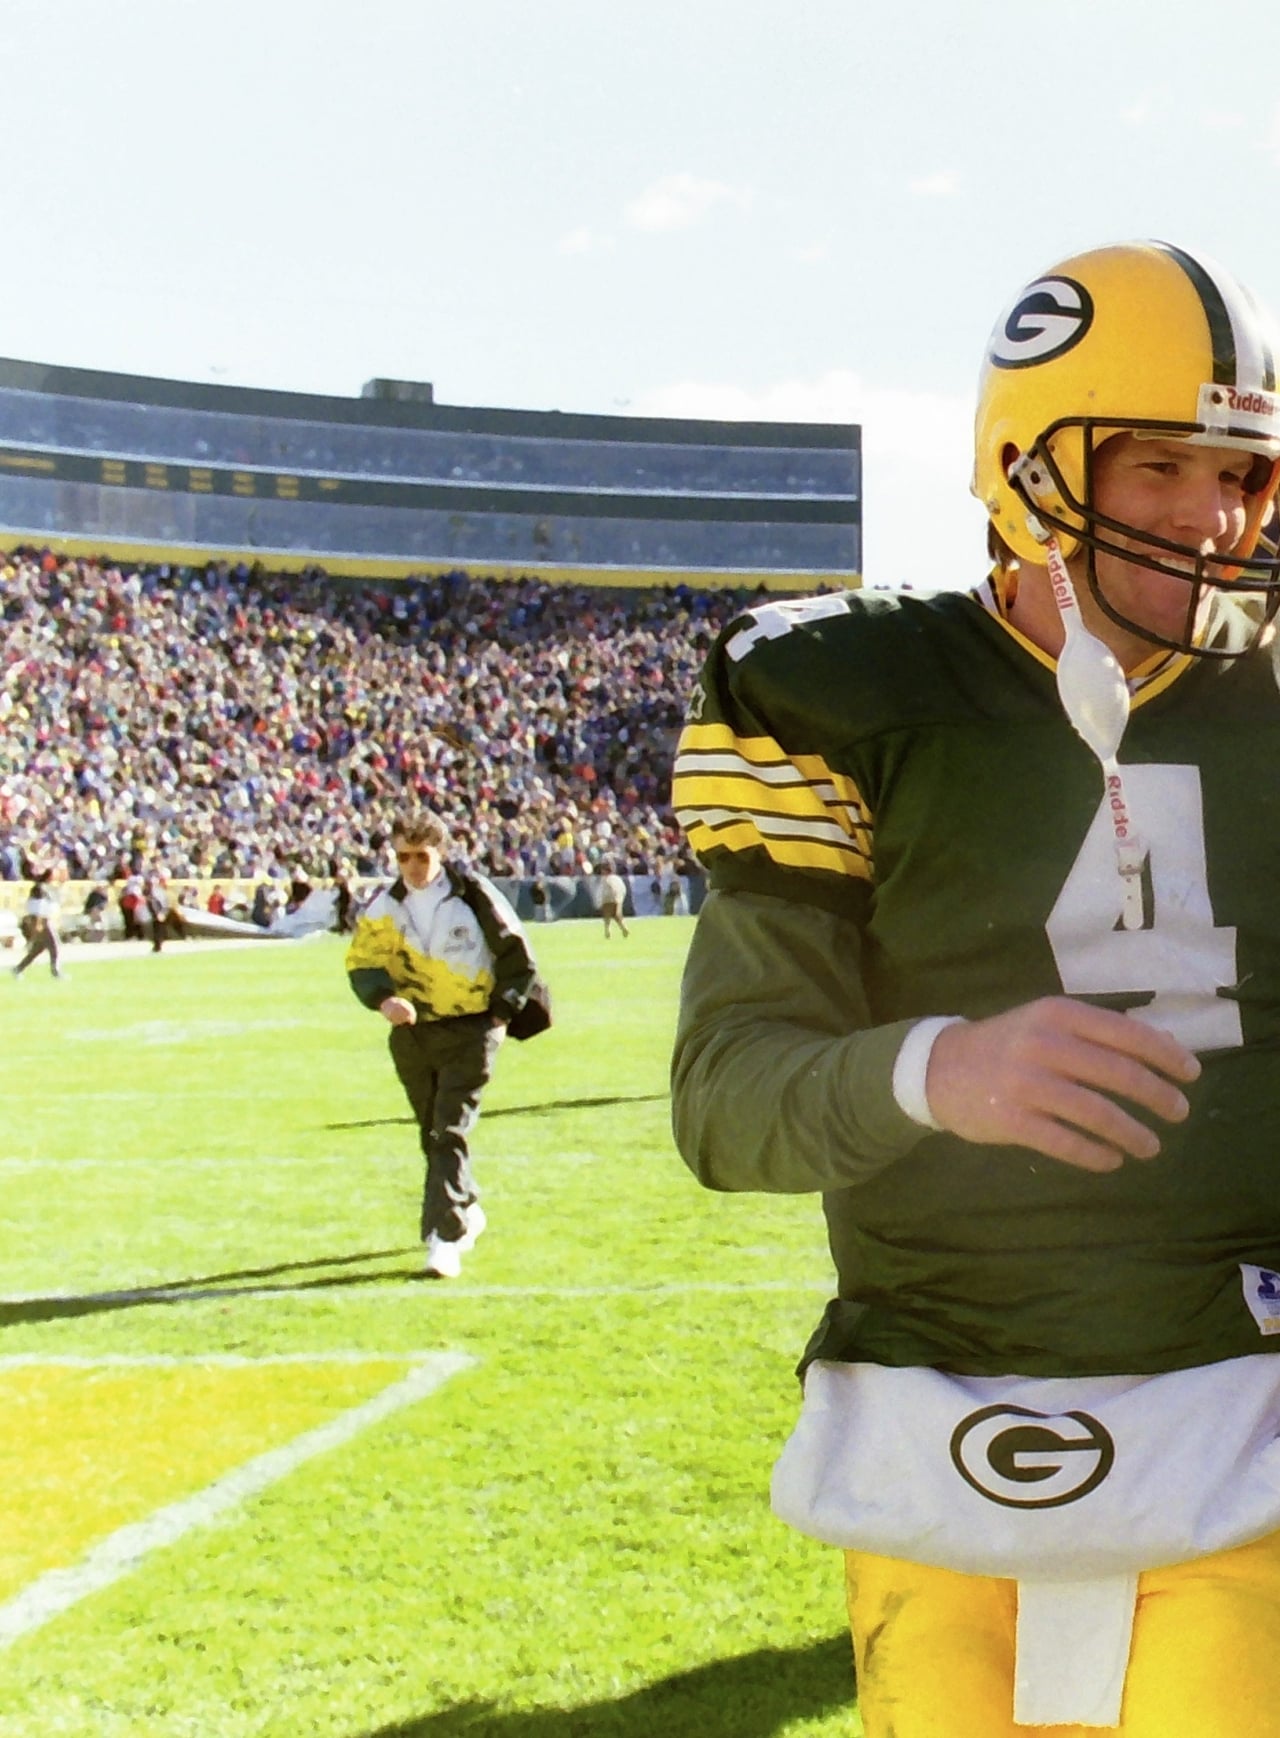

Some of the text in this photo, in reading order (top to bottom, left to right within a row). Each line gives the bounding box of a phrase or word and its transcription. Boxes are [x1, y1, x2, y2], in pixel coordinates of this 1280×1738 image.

[990, 275, 1094, 370] G
[1226, 387, 1276, 416] Ridde
[1108, 775, 1130, 838] Ridde
[1045, 763, 1243, 1050] 4
[950, 1403, 1115, 1509] G
